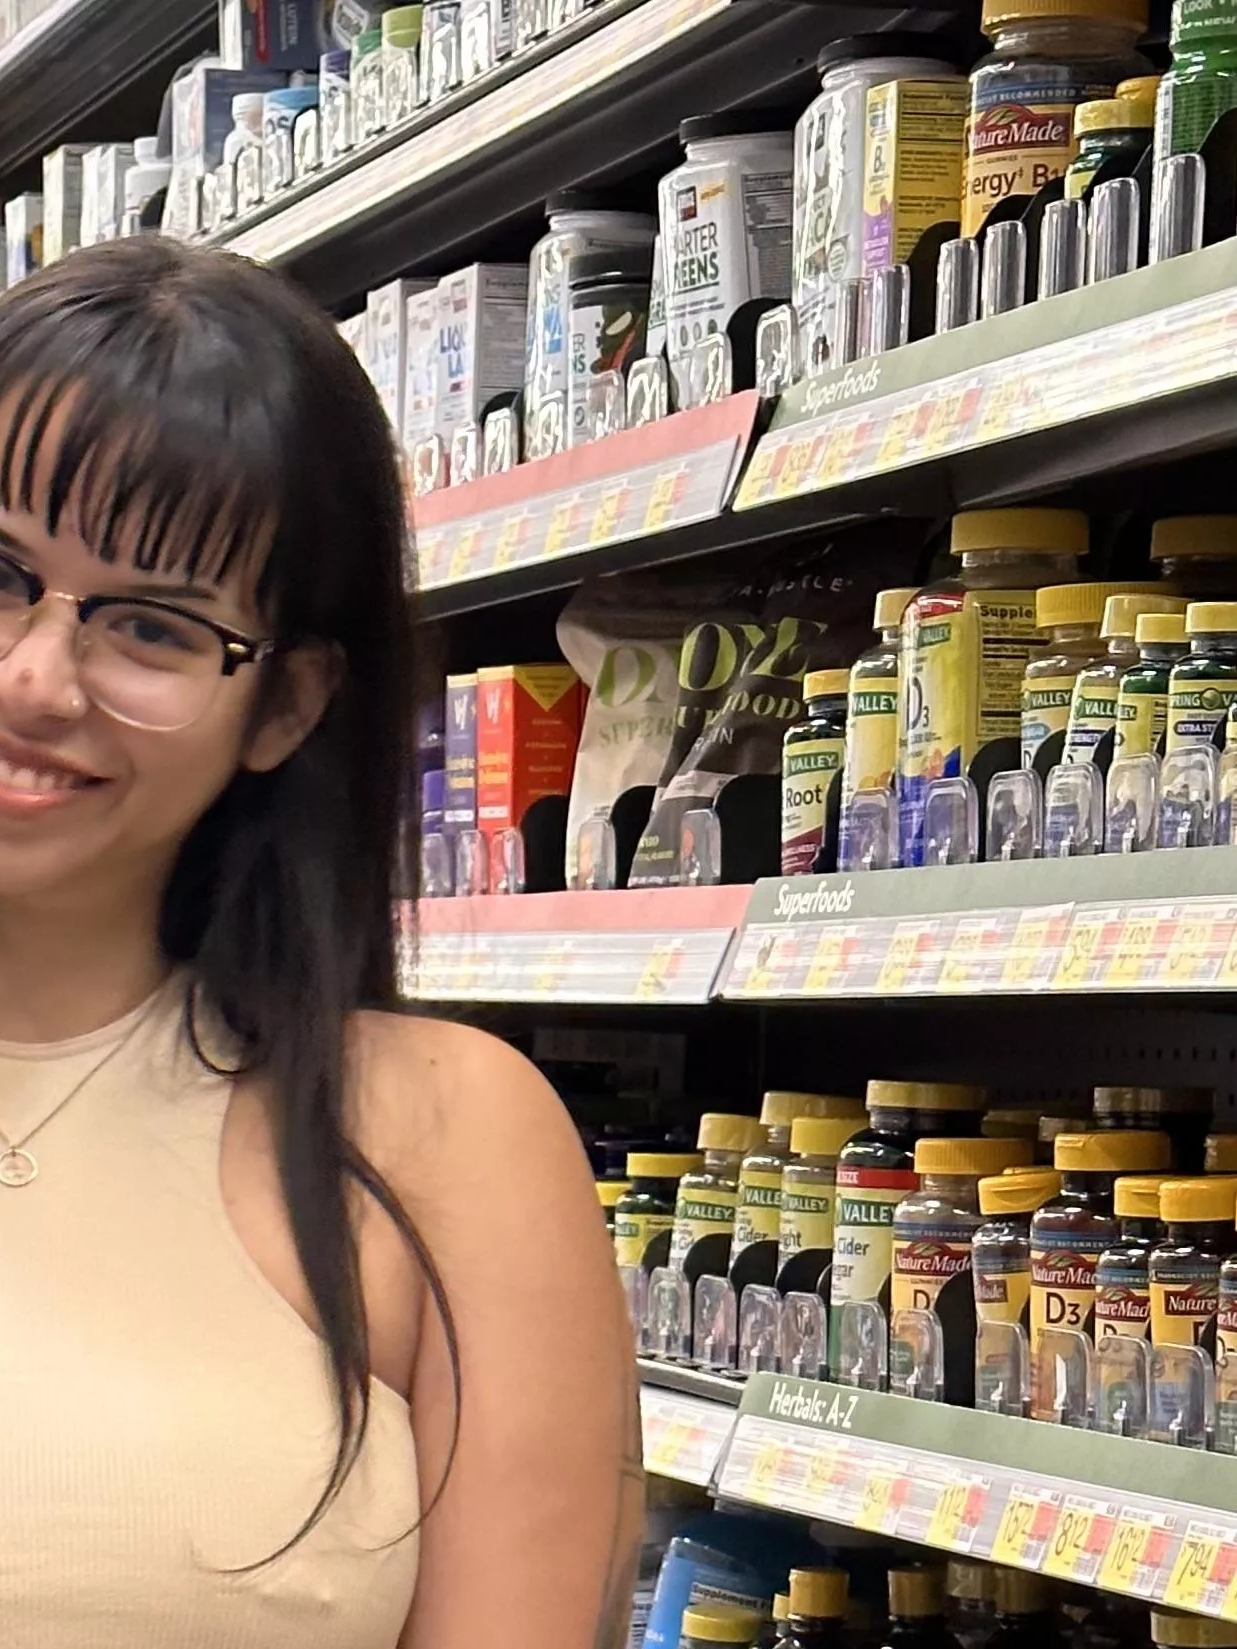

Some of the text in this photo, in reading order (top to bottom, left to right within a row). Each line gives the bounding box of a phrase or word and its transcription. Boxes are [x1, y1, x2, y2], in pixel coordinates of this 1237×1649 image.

[800, 360, 882, 416] Superfoods
[980, 604, 1033, 619] Supple
[1031, 690, 1071, 707] VALLEY
[789, 751, 838, 773] VALLEY
[786, 784, 823, 807] Root
[773, 879, 855, 922] Superfoods
[745, 1186, 782, 1206] VALLE
[685, 1202, 735, 1222] VALLEY
[836, 1236, 872, 1257] Cider
[1044, 1291, 1081, 1326] D3
[768, 1381, 860, 1430] Herbals: A-Z
